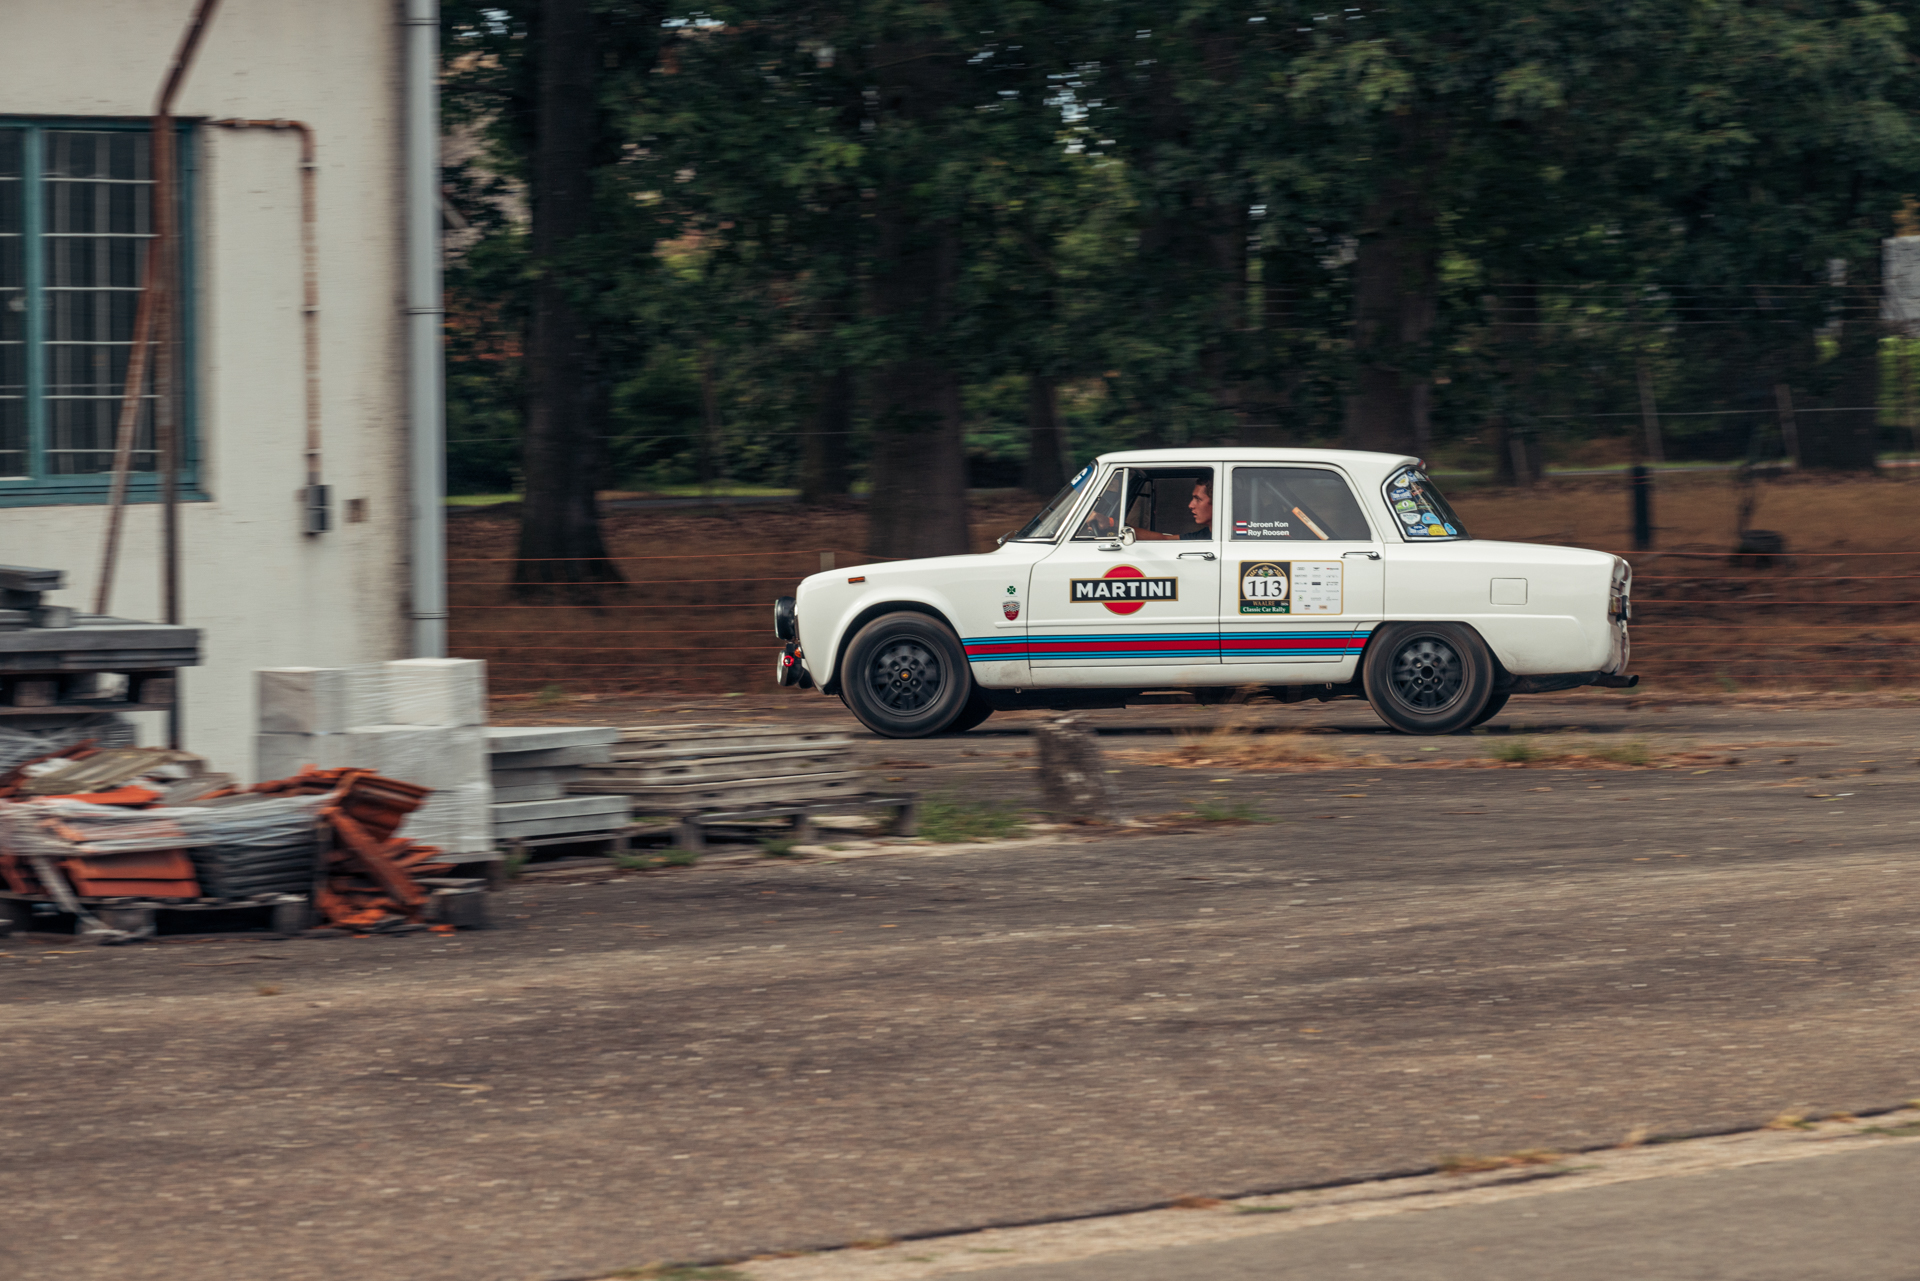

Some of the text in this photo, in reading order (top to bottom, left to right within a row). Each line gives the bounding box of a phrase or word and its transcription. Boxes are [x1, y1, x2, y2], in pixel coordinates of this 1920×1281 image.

[1248, 529, 1261, 537] Roy
[1076, 581, 1172, 598] MARTINI
[1248, 580, 1282, 597] 113
